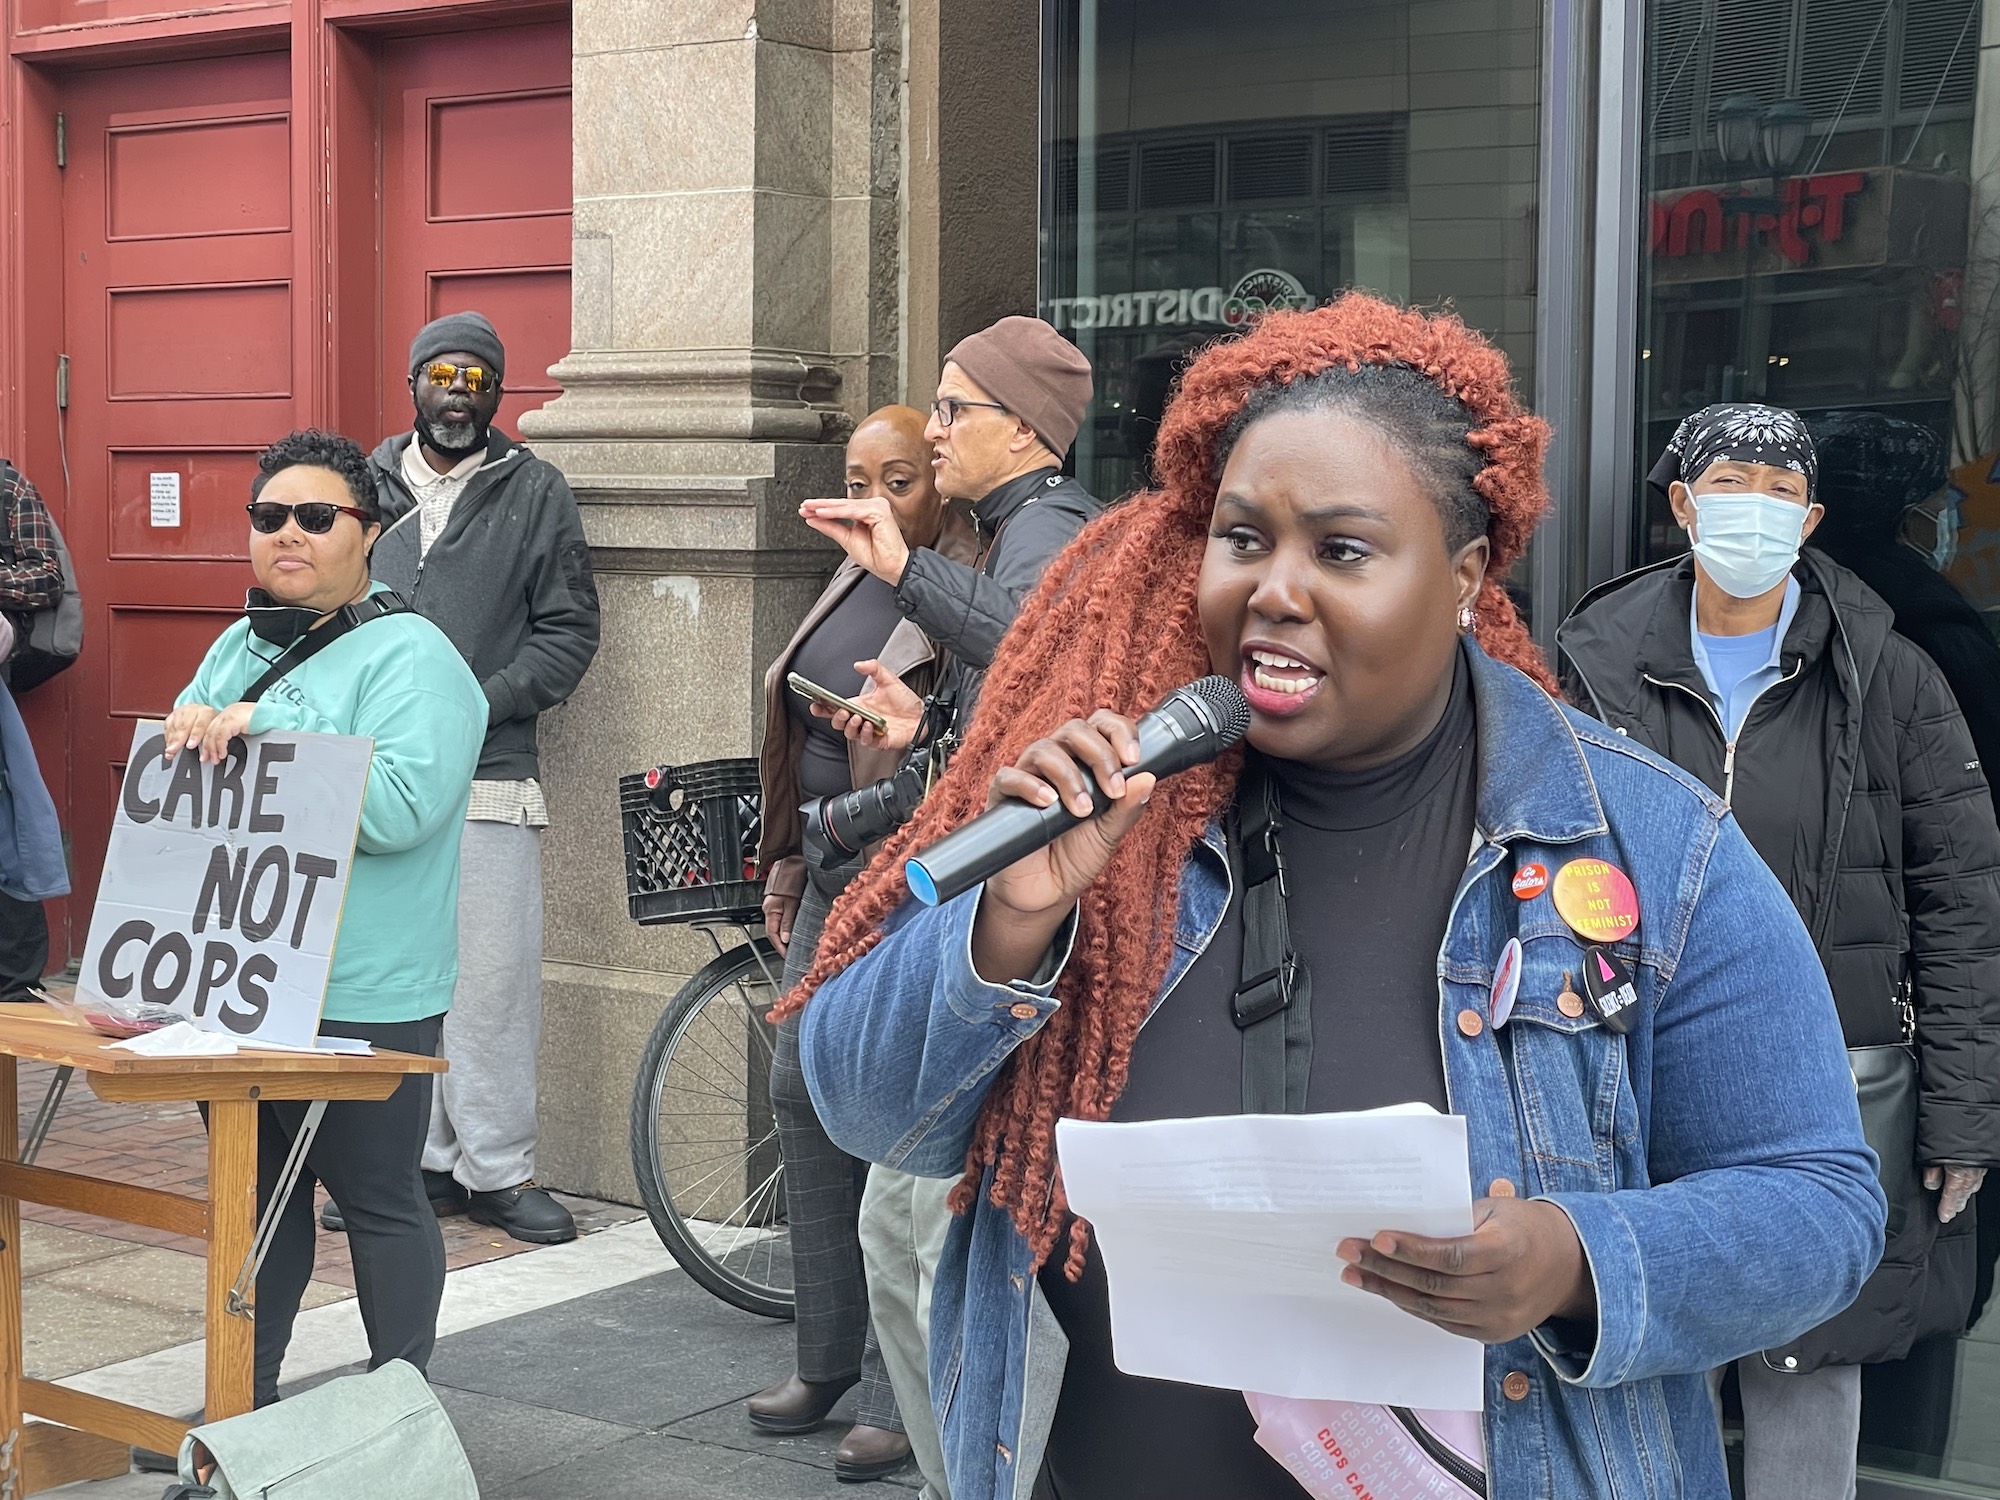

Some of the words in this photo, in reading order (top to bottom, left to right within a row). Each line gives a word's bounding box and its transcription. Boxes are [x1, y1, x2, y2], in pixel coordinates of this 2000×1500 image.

[268, 678, 305, 706] TICE
[123, 734, 296, 833] CARE
[1513, 876, 1545, 889] Gators
[1522, 866, 1536, 877] Go
[1565, 864, 1610, 877] PRISON
[192, 844, 337, 949] NOT
[1587, 881, 1601, 893] IS
[1588, 898, 1611, 911] NOT
[1576, 914, 1633, 930] FEMINIST
[98, 920, 278, 1034] COPS
[1317, 1428, 1348, 1469] COPS
[1331, 1420, 1361, 1460] COPS
[1341, 1409, 1374, 1448] COPS
[1373, 1450, 1414, 1491] CAN'T
[1300, 1440, 1333, 1480] COPS
[1426, 1474, 1461, 1500] HEA
